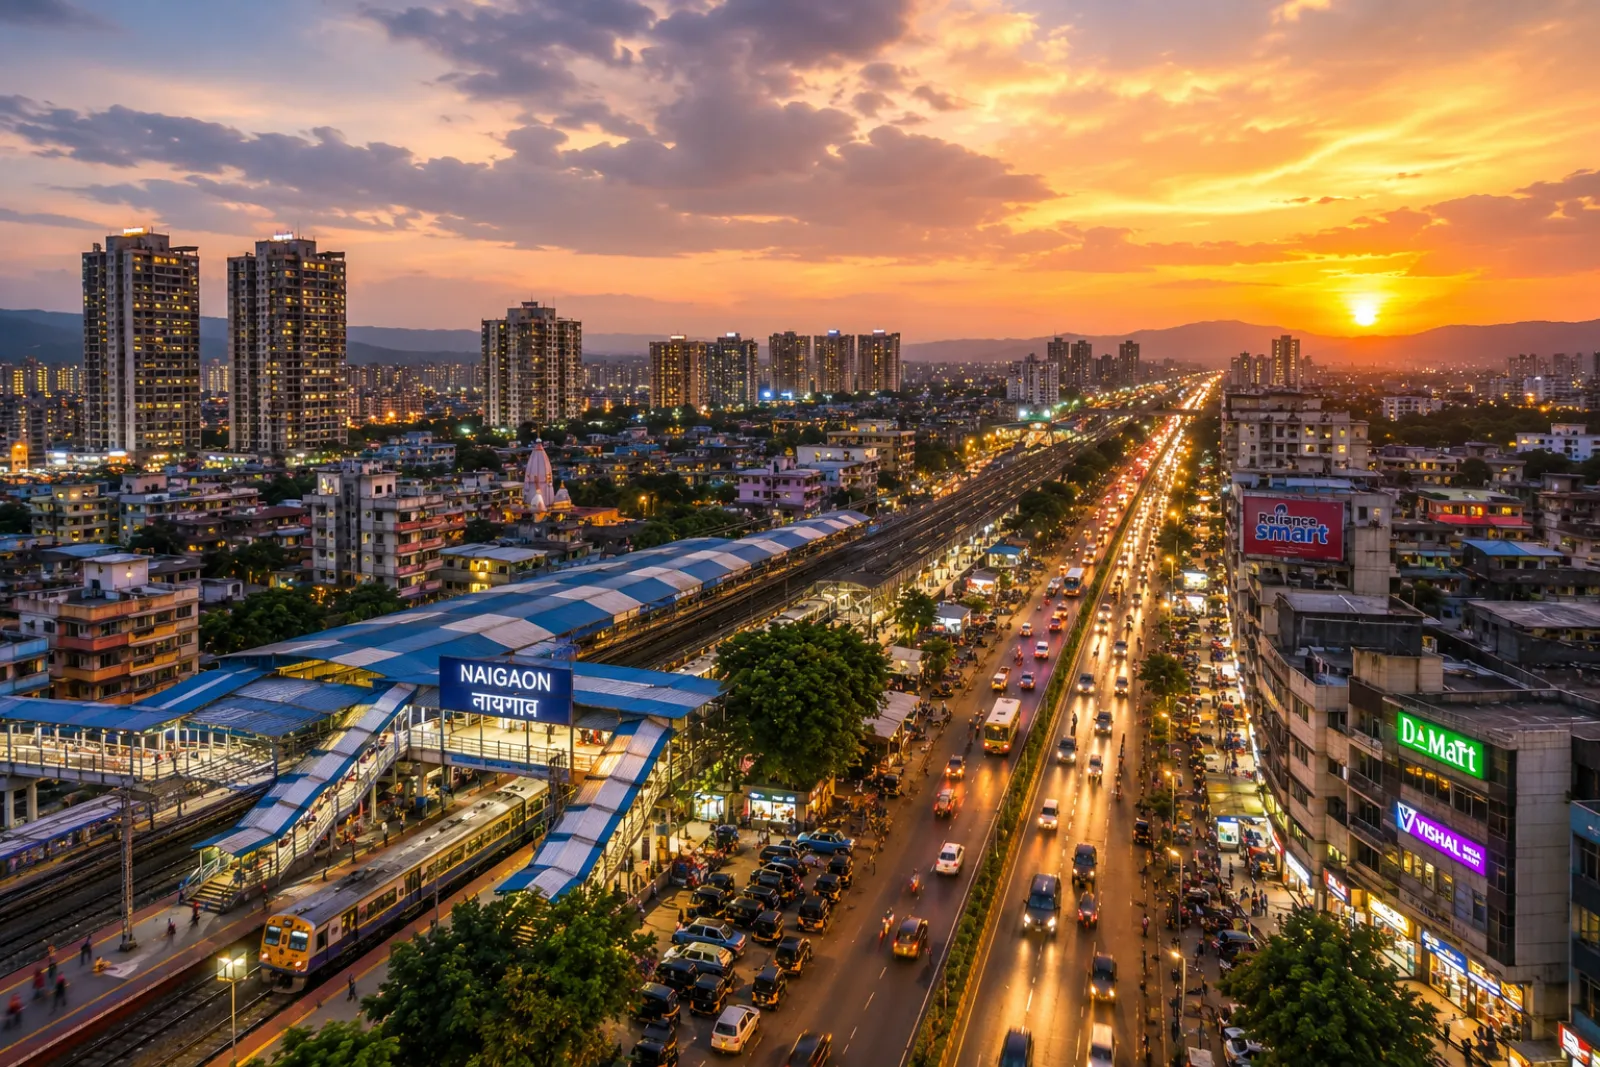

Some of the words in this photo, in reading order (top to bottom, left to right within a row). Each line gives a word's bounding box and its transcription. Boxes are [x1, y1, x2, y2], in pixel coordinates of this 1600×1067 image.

[1258, 512, 1318, 527] Reliance
[1256, 523, 1329, 544] smart
[460, 664, 551, 692] NAIGAON
[1416, 818, 1462, 857] VISHAL
